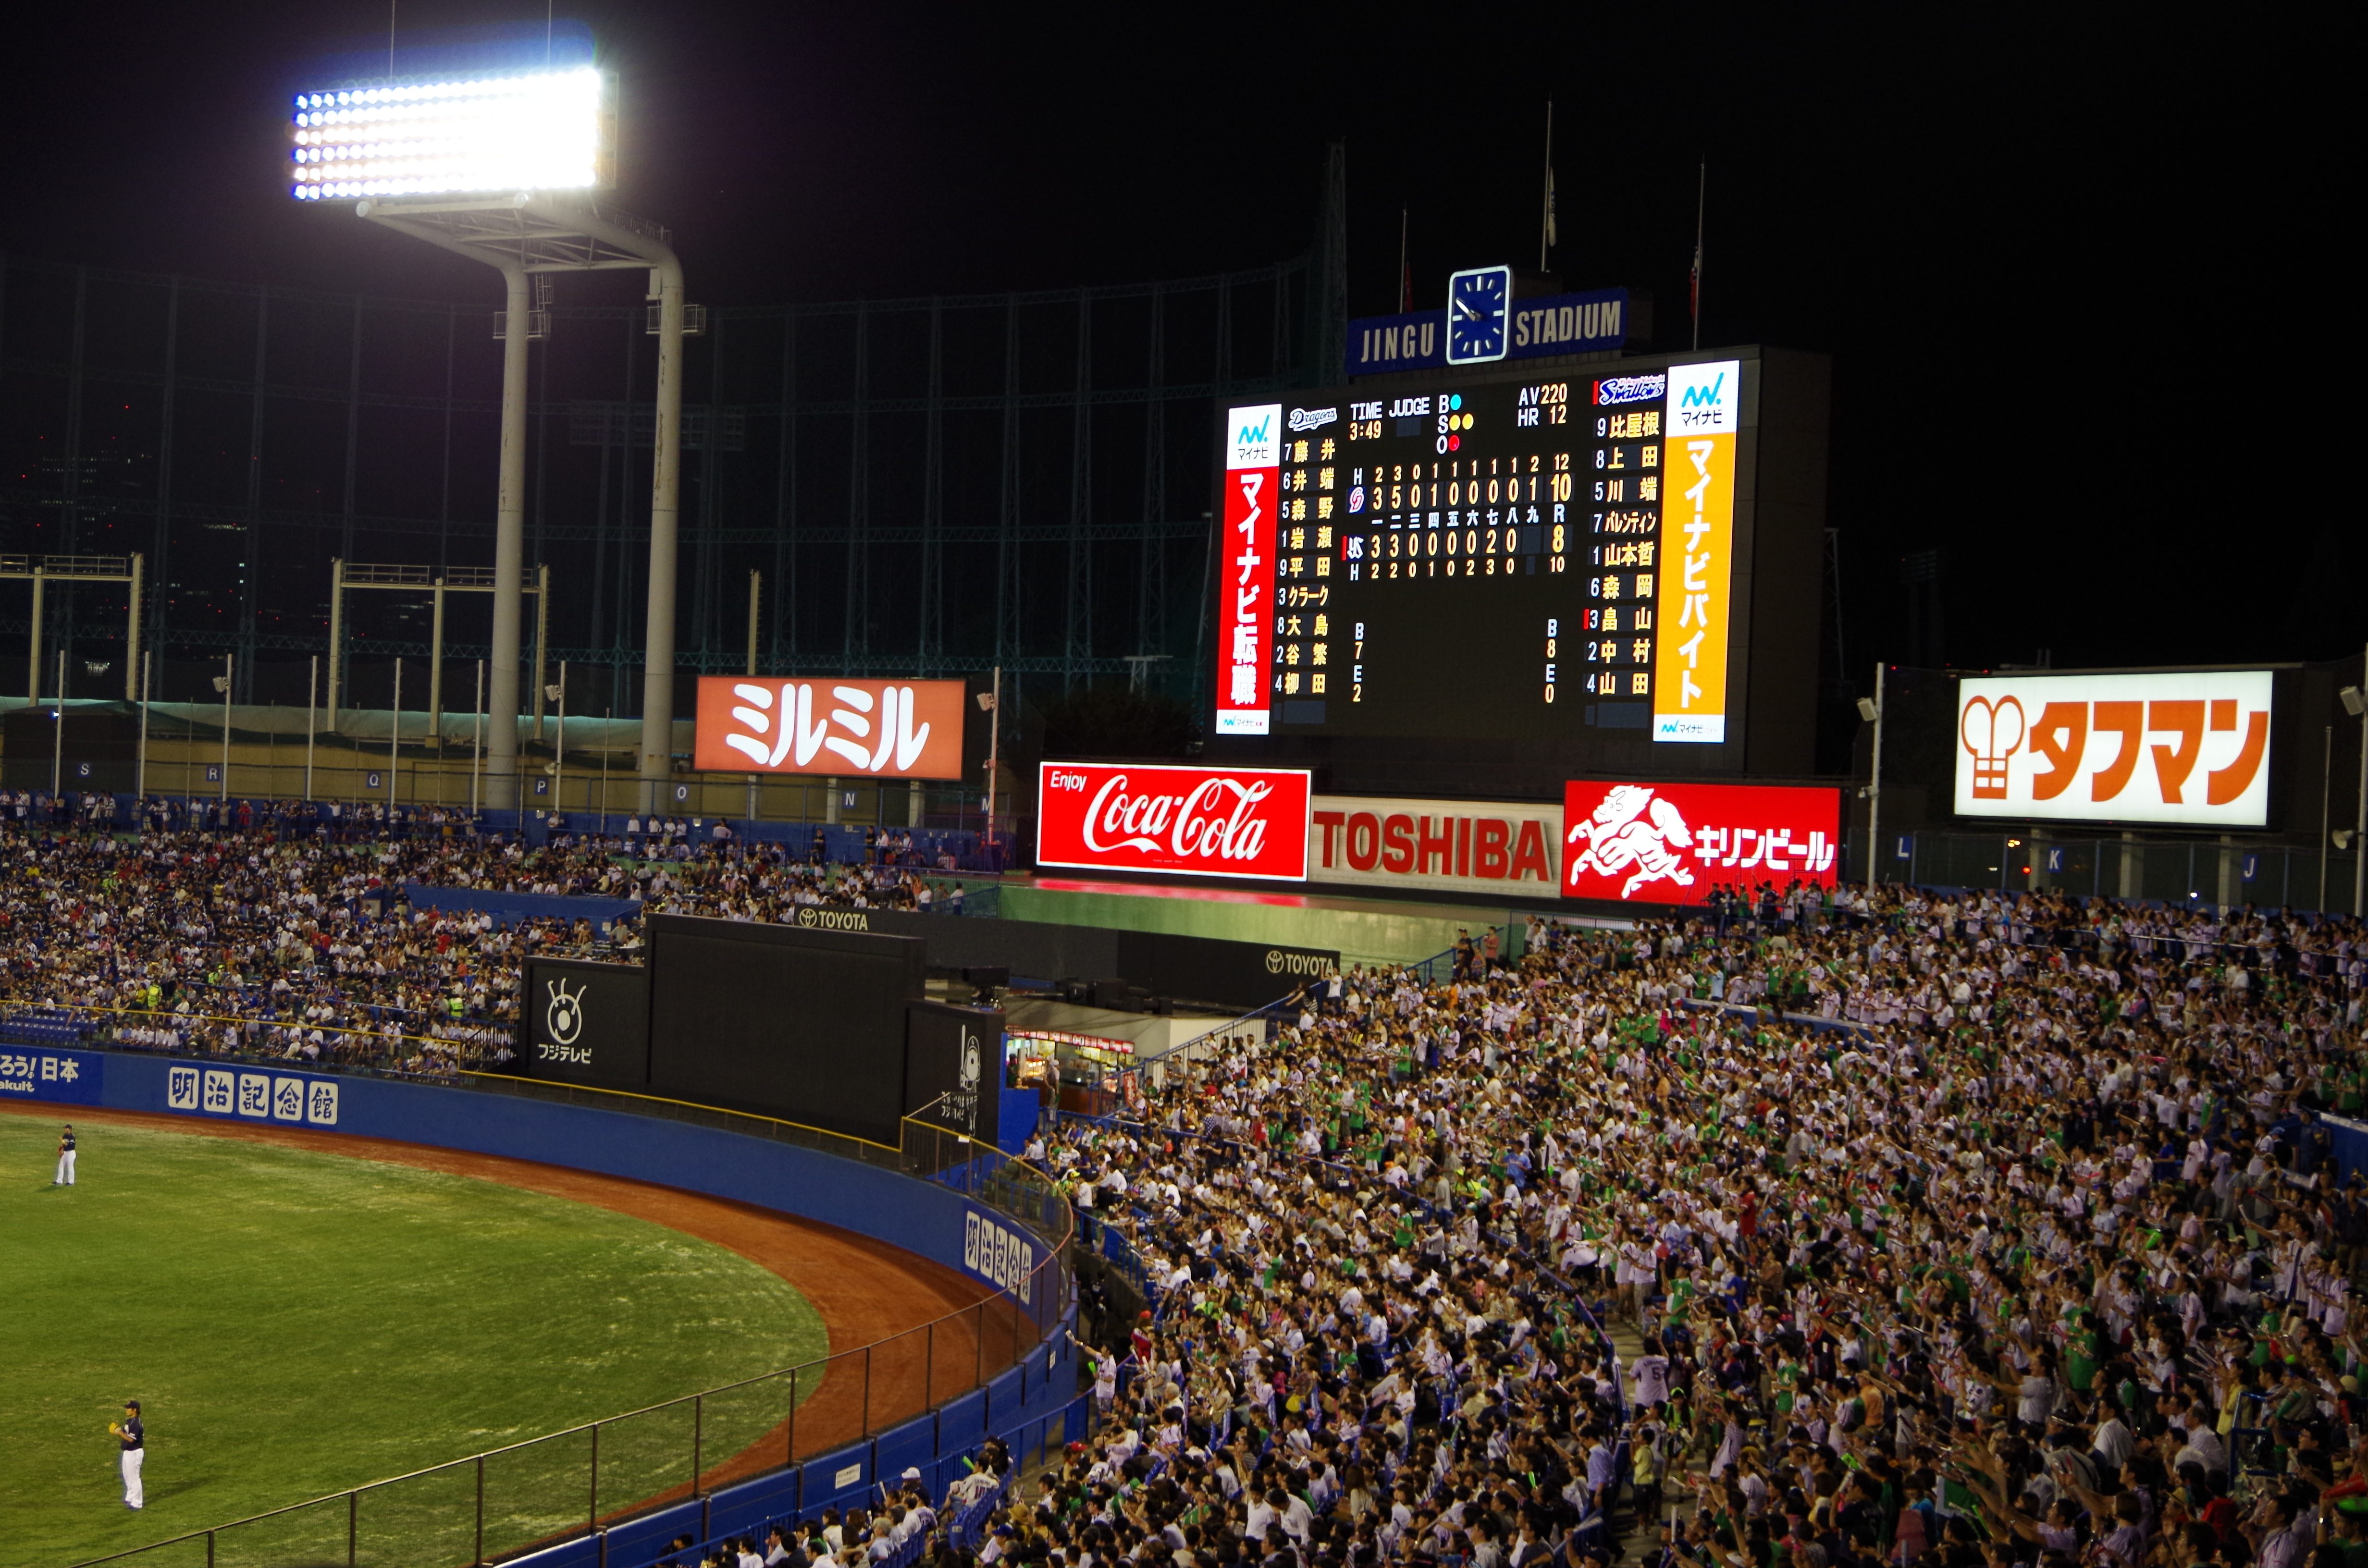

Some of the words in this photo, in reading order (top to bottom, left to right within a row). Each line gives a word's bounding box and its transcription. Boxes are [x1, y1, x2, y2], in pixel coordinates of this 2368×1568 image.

[1361, 323, 1434, 363] JINGU
[1516, 301, 1621, 346] STADIUM
[1519, 387, 1540, 406] AV
[1541, 383, 1567, 405] 220
[1599, 379, 1665, 405] Swallows
[1351, 402, 1382, 421] TIME
[1389, 397, 1430, 417] JUDGE
[1439, 395, 1449, 413] B
[1288, 407, 1338, 431] Dragons
[1438, 415, 1448, 434] S
[1518, 408, 1539, 427] HR
[1550, 405, 1566, 424] 12
[1597, 418, 1606, 437] 9
[1609, 412, 1659, 438] 比屋根
[1682, 410, 1722, 427] マイナビ
[1350, 420, 1381, 440] 3:49
[1238, 447, 1269, 460] マイナビ
[1285, 443, 1292, 461] 7
[1294, 439, 1335, 463] 藤井
[1596, 450, 1604, 468] 8
[1608, 446, 1657, 469] 上田
[1283, 473, 1290, 490] 6
[1293, 467, 1334, 491] 井端
[1354, 468, 1362, 485] H
[1375, 467, 1382, 482] 2
[1394, 466, 1401, 481] 3
[1413, 465, 1420, 479] 0
[1433, 463, 1438, 478] 1
[1453, 462, 1457, 477] 1
[1472, 460, 1477, 476] 1
[1492, 459, 1496, 474] 1
[1512, 457, 1517, 473] 1
[1530, 456, 1539, 472] 2
[1555, 453, 1569, 470] 12
[1373, 487, 1382, 510] 3
[1392, 486, 1401, 509] 5
[1411, 484, 1420, 507] 0
[1431, 483, 1437, 506] 1
[1449, 482, 1458, 505] 0
[1469, 481, 1478, 504] 0
[1489, 479, 1498, 503] 0
[1508, 478, 1518, 502] 0
[1530, 477, 1536, 501] 1
[1551, 473, 1571, 502] 10
[1595, 482, 1603, 501] 5
[1607, 476, 1657, 502] 川端
[1282, 502, 1289, 518] 5
[1292, 497, 1333, 521] 森野
[1390, 515, 1401, 529] 二
[1409, 514, 1420, 528] 三
[1429, 512, 1439, 528] 四
[1447, 511, 1458, 527] 五
[1467, 510, 1479, 526] 六
[1487, 509, 1498, 525] 七
[1506, 507, 1518, 524] 八
[1527, 505, 1539, 523] 九
[1554, 504, 1565, 523] R
[1594, 514, 1602, 533] 7
[1605, 511, 1656, 533] バレンティン
[1283, 530, 1286, 547] 1
[1291, 526, 1332, 550] 岩瀬
[1371, 535, 1380, 558] 3
[1390, 534, 1398, 557] 3
[1409, 533, 1418, 556] 0
[1428, 532, 1437, 555] 0
[1447, 531, 1456, 554] 0
[1467, 530, 1476, 554] 0
[1486, 529, 1496, 553] 2
[1506, 528, 1516, 552] 0
[1553, 525, 1564, 552] 8
[1594, 546, 1599, 564] 1
[1604, 541, 1654, 566] 山本哲
[1280, 559, 1287, 576] 9
[1289, 557, 1330, 577] 平田
[1350, 564, 1358, 580] H
[1371, 564, 1379, 578] 2
[1390, 563, 1397, 578] 2
[1409, 562, 1416, 577] 0
[1429, 561, 1433, 576] 1
[1447, 561, 1455, 576] 0
[1467, 560, 1474, 575] 2
[1486, 559, 1494, 575] 3
[1506, 558, 1514, 574] 0
[1551, 556, 1565, 572] 10
[1678, 441, 1714, 708] マイナビバイト
[1231, 473, 1264, 705] マイナビ転職
[1279, 588, 1285, 605] 3
[1289, 585, 1328, 606] クラーク
[1591, 578, 1599, 597] 6
[1603, 574, 1653, 599] 森岡
[1278, 617, 1284, 634] 8
[1287, 613, 1328, 636] 大島
[1548, 619, 1557, 637] B
[1590, 610, 1598, 628] 3
[1602, 607, 1651, 631] 畠山
[1356, 623, 1364, 640] B
[1276, 646, 1283, 663] 2
[1286, 643, 1327, 665] 谷繁
[1355, 641, 1363, 659] 7
[1547, 639, 1555, 658] 8
[1588, 642, 1597, 661] 2
[1601, 638, 1650, 663] 中村
[1275, 674, 1282, 691] 4
[1354, 665, 1362, 682] E
[1546, 664, 1555, 682] E
[1587, 674, 1595, 692] 4
[1600, 672, 1648, 695] 山田
[1353, 684, 1361, 702] 2
[1545, 684, 1554, 703] 0
[726, 684, 929, 772] ミルミル
[1679, 724, 1703, 734] マイナビ
[2029, 700, 2269, 805] タフマン
[81, 764, 90, 776] S
[209, 769, 217, 780] R
[370, 775, 379, 787] Q
[1050, 771, 1087, 792] Enjoy
[537, 781, 546, 793] P
[845, 793, 855, 806] N
[1313, 811, 1549, 881] TOSHIBA
[1695, 825, 1835, 871] キリンビール
[1898, 838, 1909, 858] L
[2049, 850, 2059, 870] K
[2245, 858, 2255, 878] J
[819, 911, 868, 931] TOYOTA
[1286, 954, 1333, 977] TOYOTA
[539, 1043, 592, 1064] フジテレビ
[172, 1071, 334, 1120] 明治記念館
[968, 1217, 1029, 1296] 明治記念館
